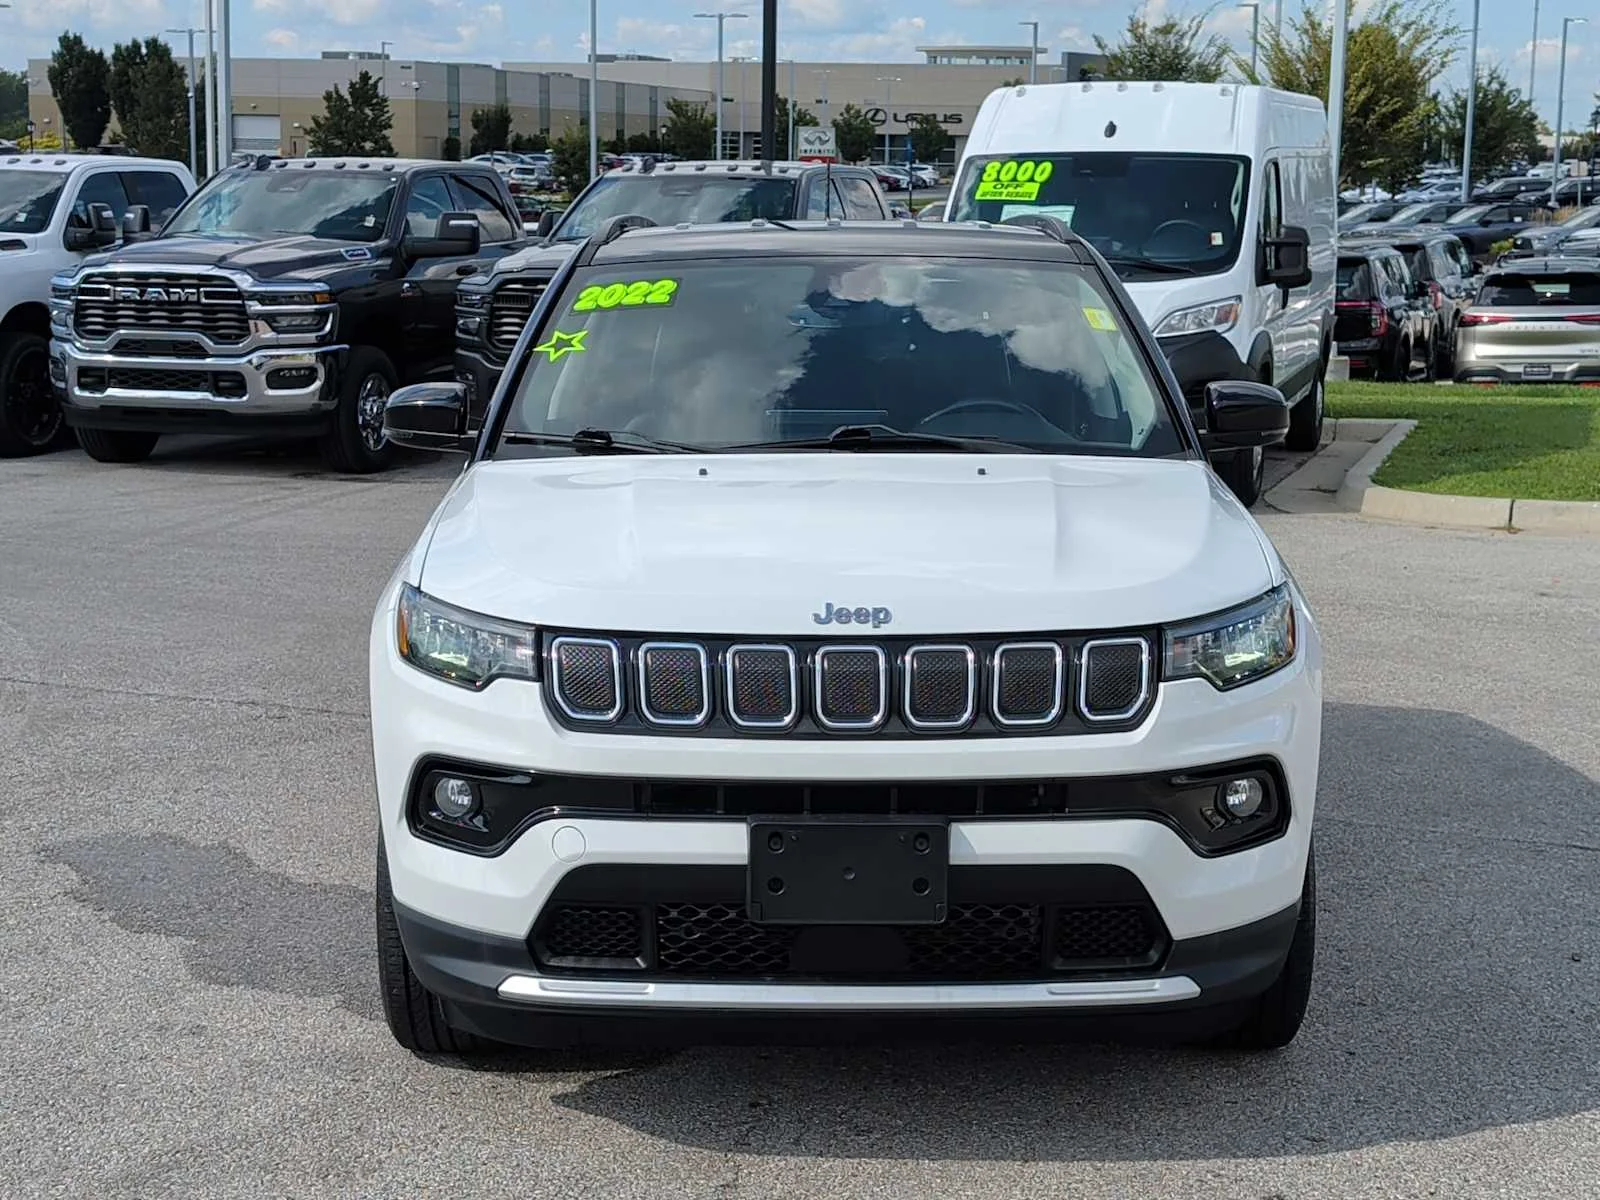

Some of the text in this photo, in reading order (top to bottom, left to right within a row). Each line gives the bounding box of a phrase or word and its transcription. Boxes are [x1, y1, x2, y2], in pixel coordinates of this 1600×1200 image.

[893, 112, 963, 124] LEUS
[982, 160, 1054, 184] 8000
[114, 286, 198, 301] RAM
[572, 278, 678, 312] 2022
[812, 601, 893, 629] Jeep
